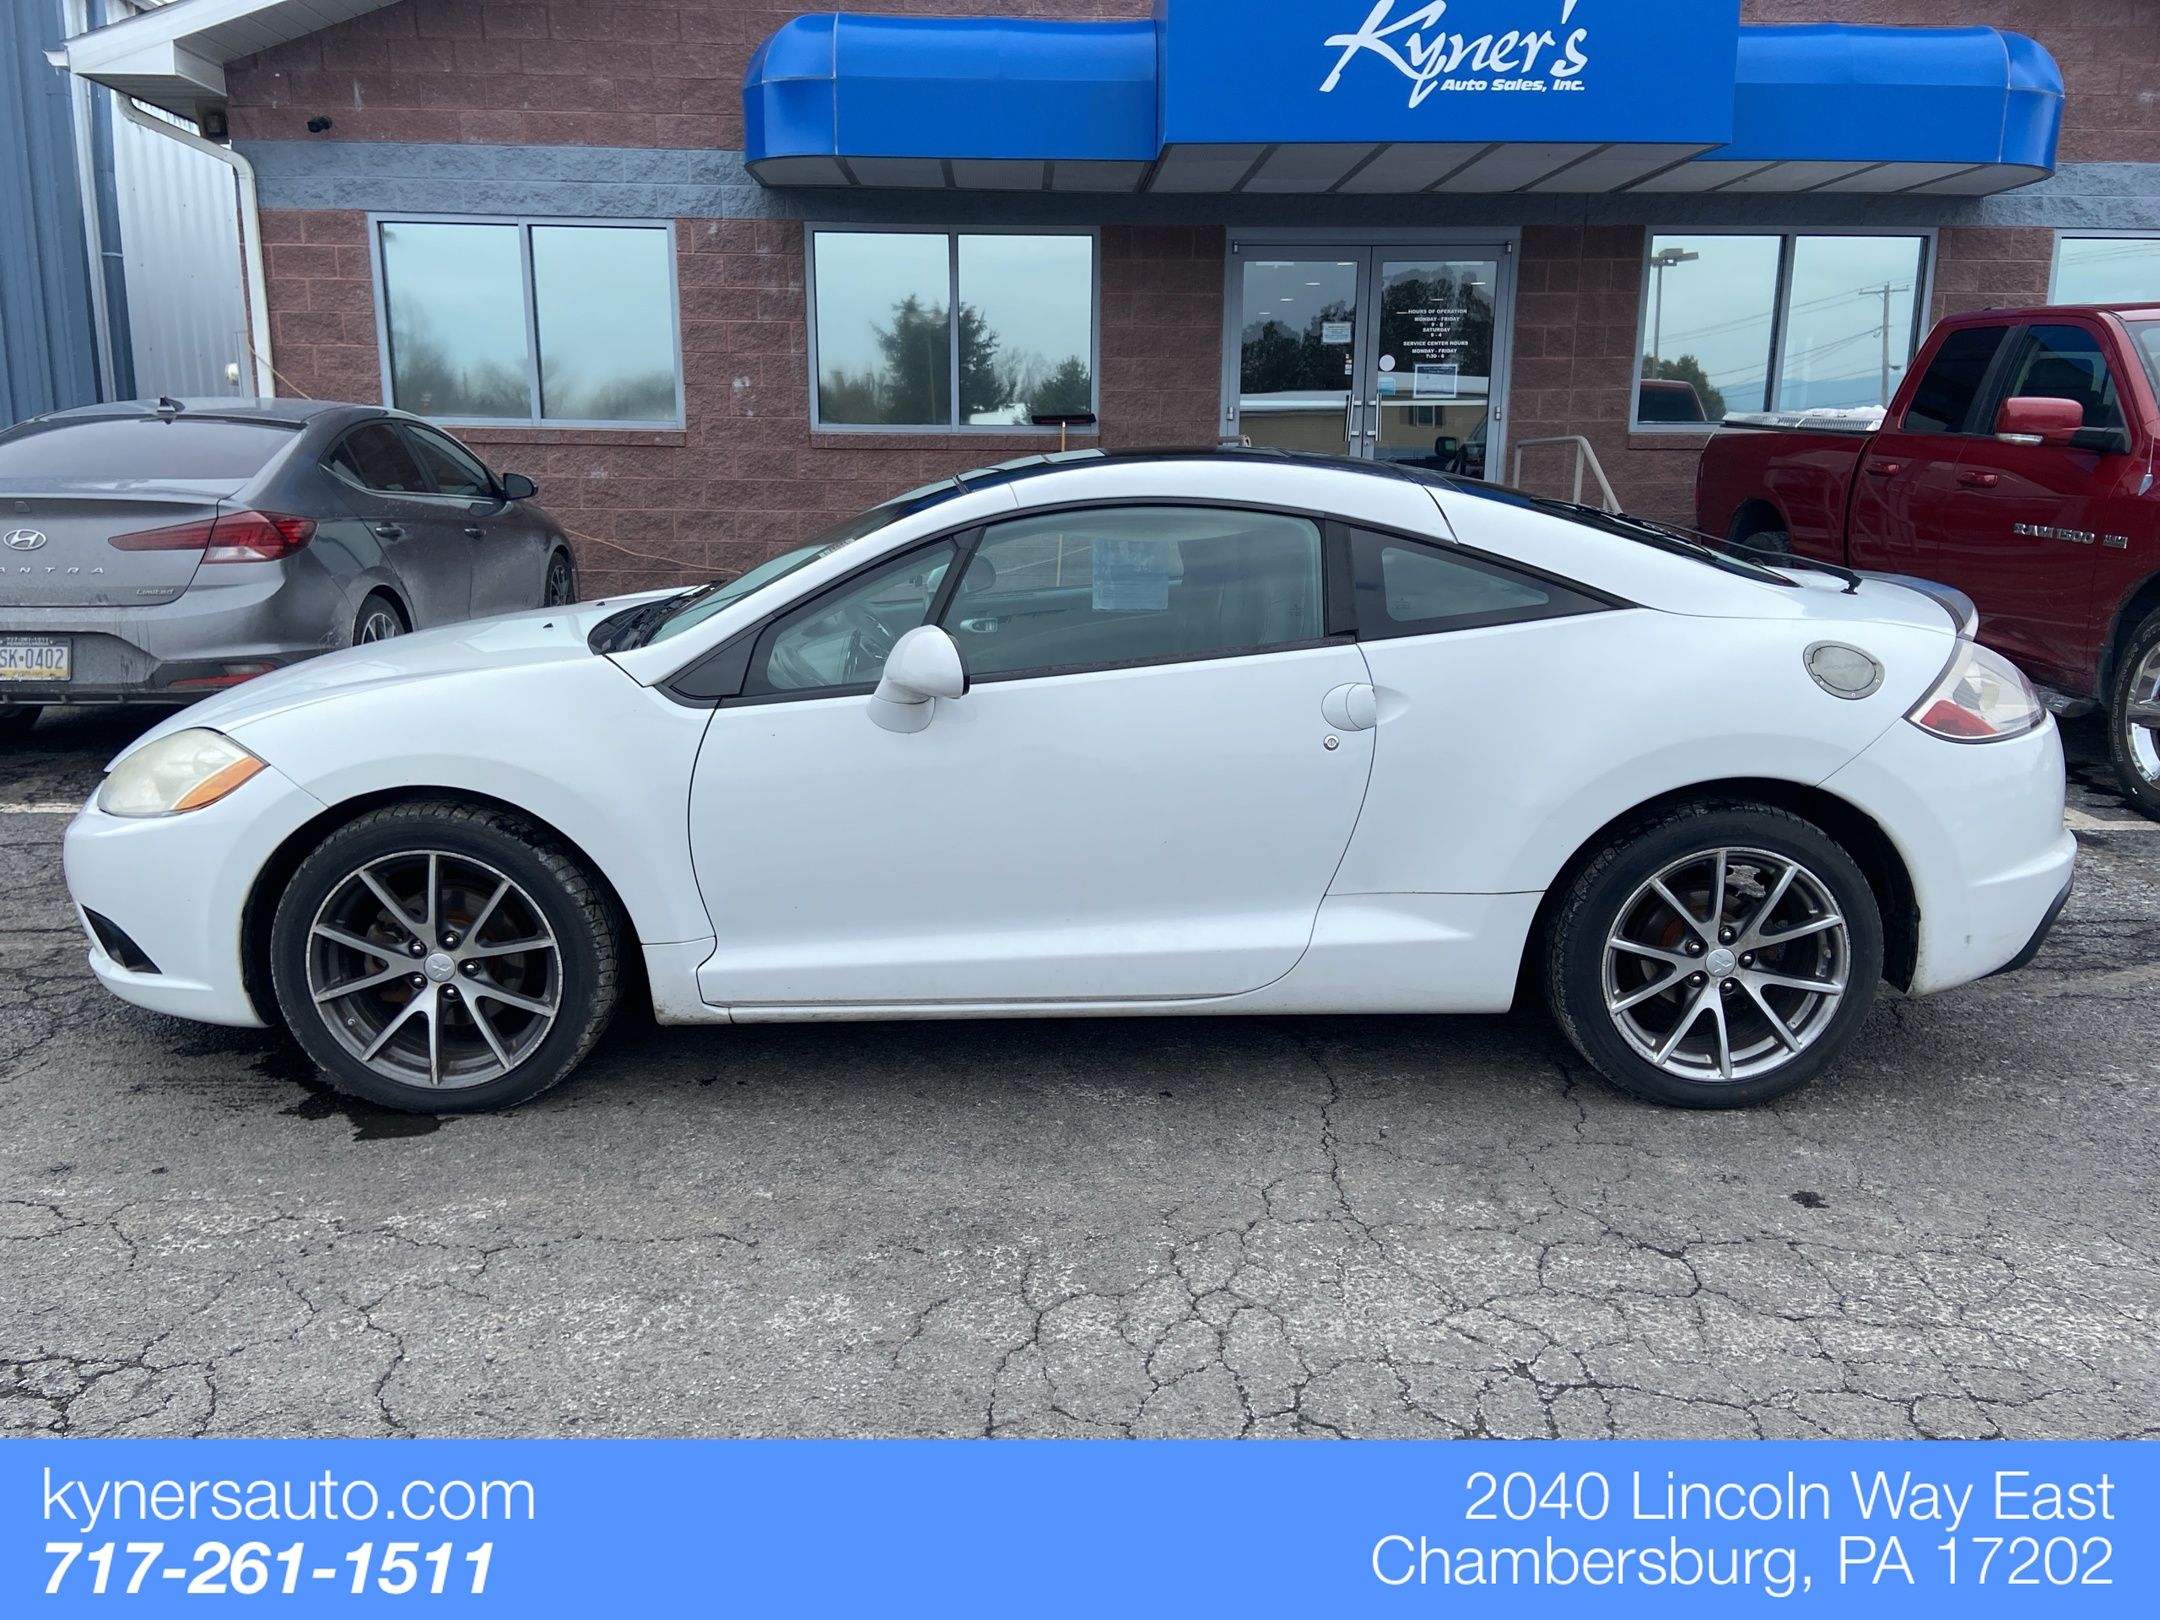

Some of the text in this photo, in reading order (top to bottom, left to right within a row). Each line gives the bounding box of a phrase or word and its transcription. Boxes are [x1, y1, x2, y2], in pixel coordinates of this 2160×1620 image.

[1319, 0, 1588, 108] Kyner's
[1440, 79, 1585, 92] Auto Sales, Inc.
[2013, 523, 2054, 539] RAM
